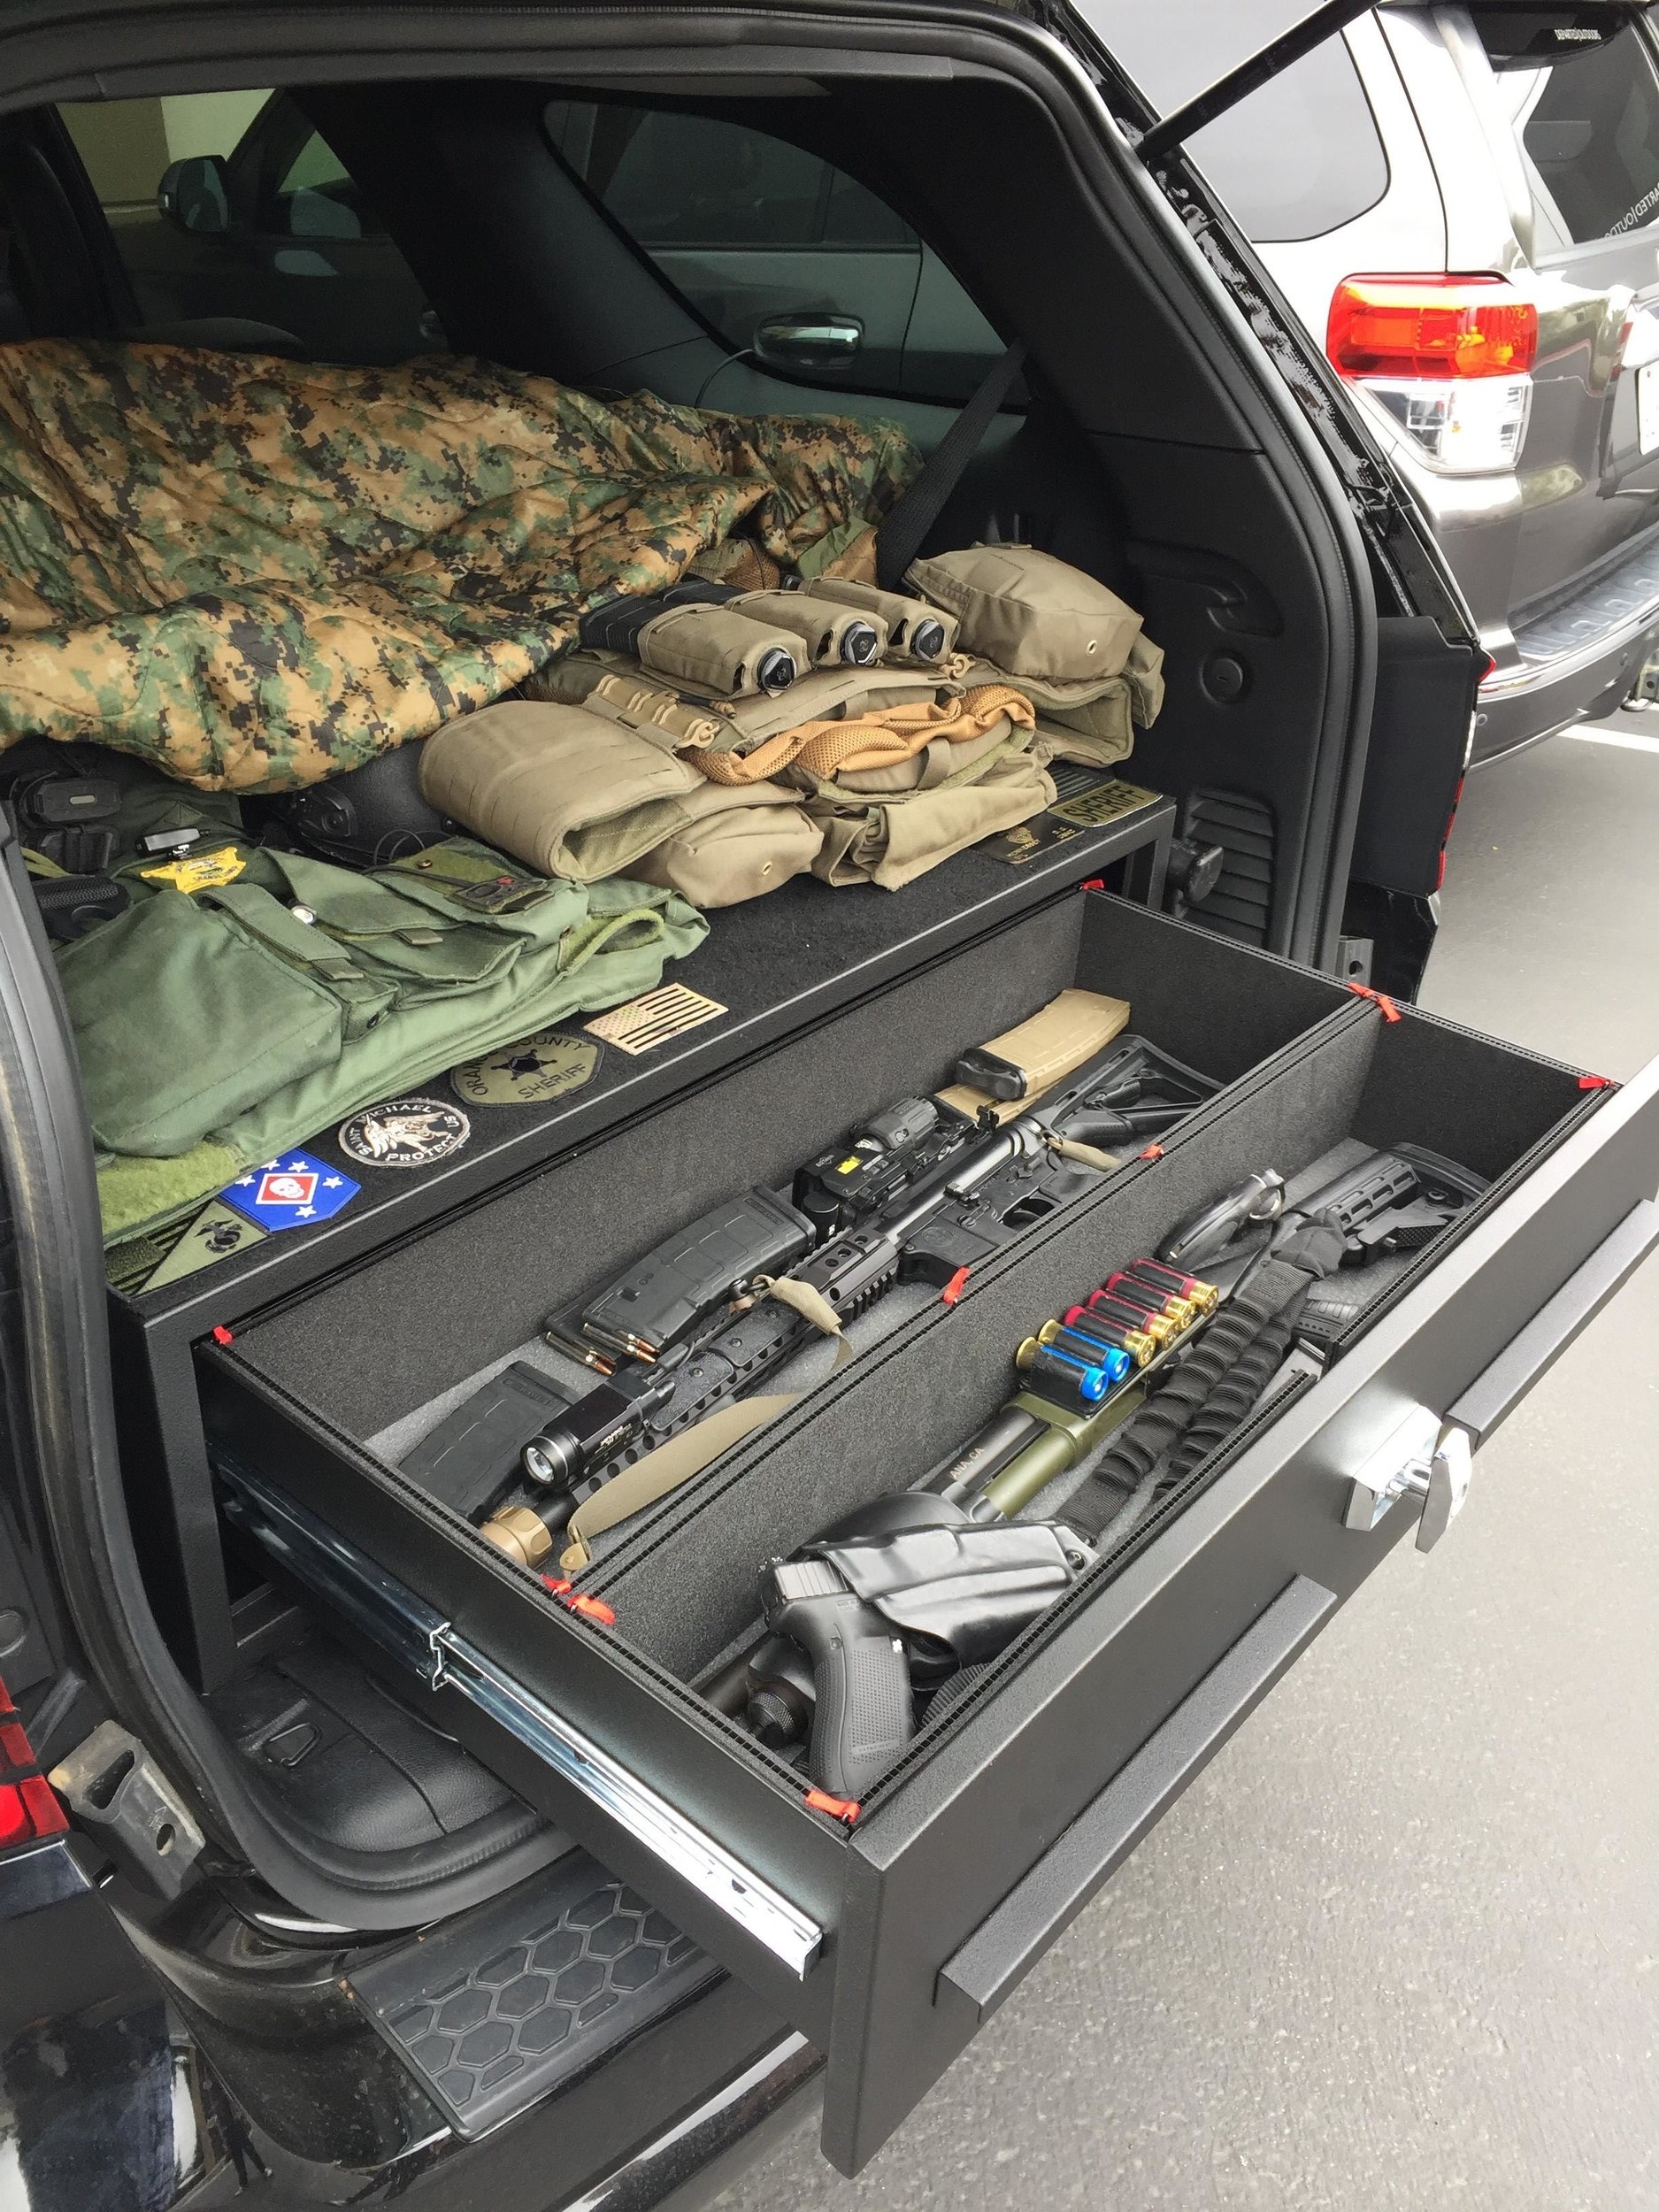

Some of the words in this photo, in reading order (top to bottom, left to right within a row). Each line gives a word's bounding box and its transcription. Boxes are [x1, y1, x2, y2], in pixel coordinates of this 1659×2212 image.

[1063, 785, 1145, 822] SHERIFF
[518, 1063, 586, 1099] SHERIFF
[355, 1104, 432, 1124] MICHAEL
[349, 1127, 373, 1156] SAINT
[385, 1133, 457, 1162] PROTECT
[443, 1116, 460, 1128] US
